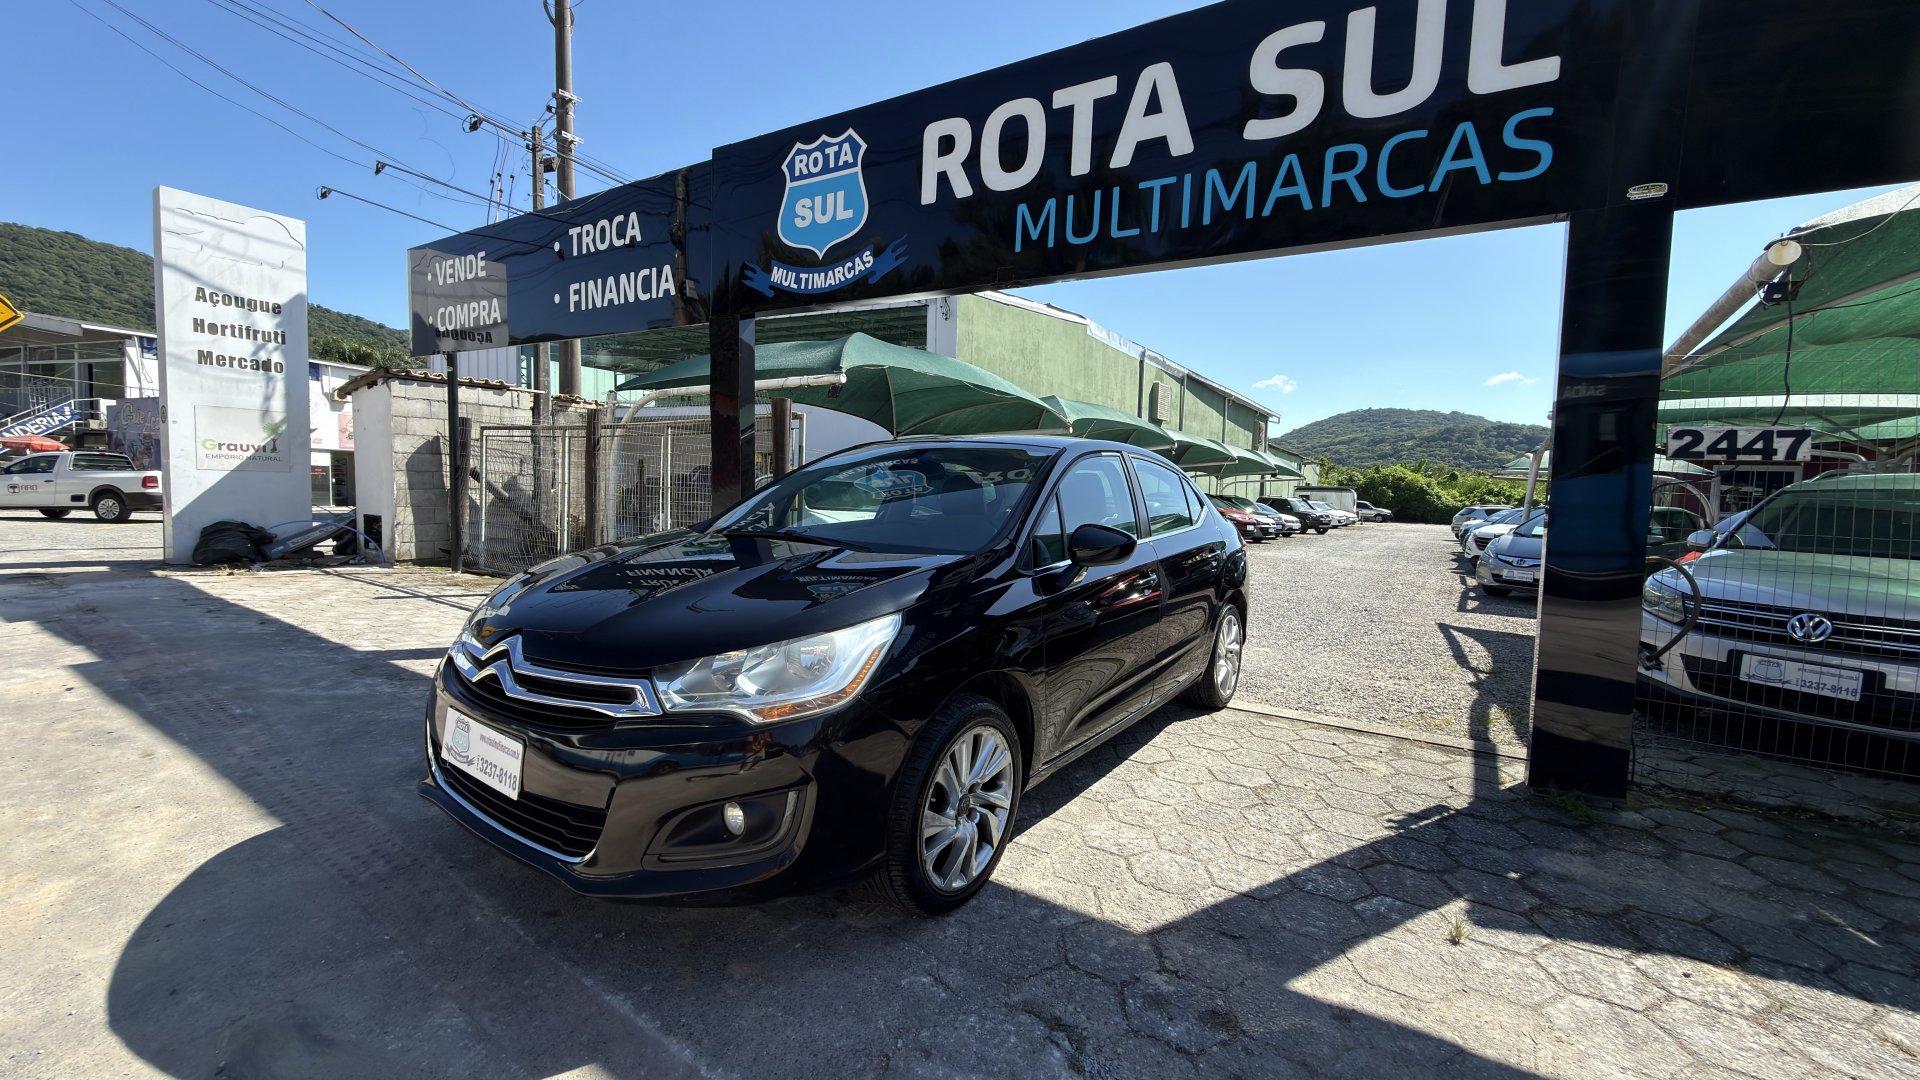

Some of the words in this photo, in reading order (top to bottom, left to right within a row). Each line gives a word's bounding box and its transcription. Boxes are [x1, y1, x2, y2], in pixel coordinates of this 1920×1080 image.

[920, 62, 1194, 205] ROTA
[1242, 0, 1561, 140] SUL
[794, 142, 854, 177] ROTA
[1014, 106, 1554, 253] MULTIMARCAS
[794, 190, 853, 228] SUL
[569, 211, 642, 257] TROCA
[435, 251, 486, 286] VENDE
[770, 250, 874, 290] MULTIMARCAS
[194, 286, 282, 314] Açougue
[569, 264, 676, 313] FINANCIA
[192, 317, 286, 345] Hortifruti
[437, 297, 502, 332] COMPRA
[197, 349, 284, 373] Mercado
[205, 452, 245, 461] EMPÓRIO
[1668, 429, 1812, 461] 2447
[1801, 679, 1859, 698] 3237-8118
[480, 756, 518, 792] 3237-8118
